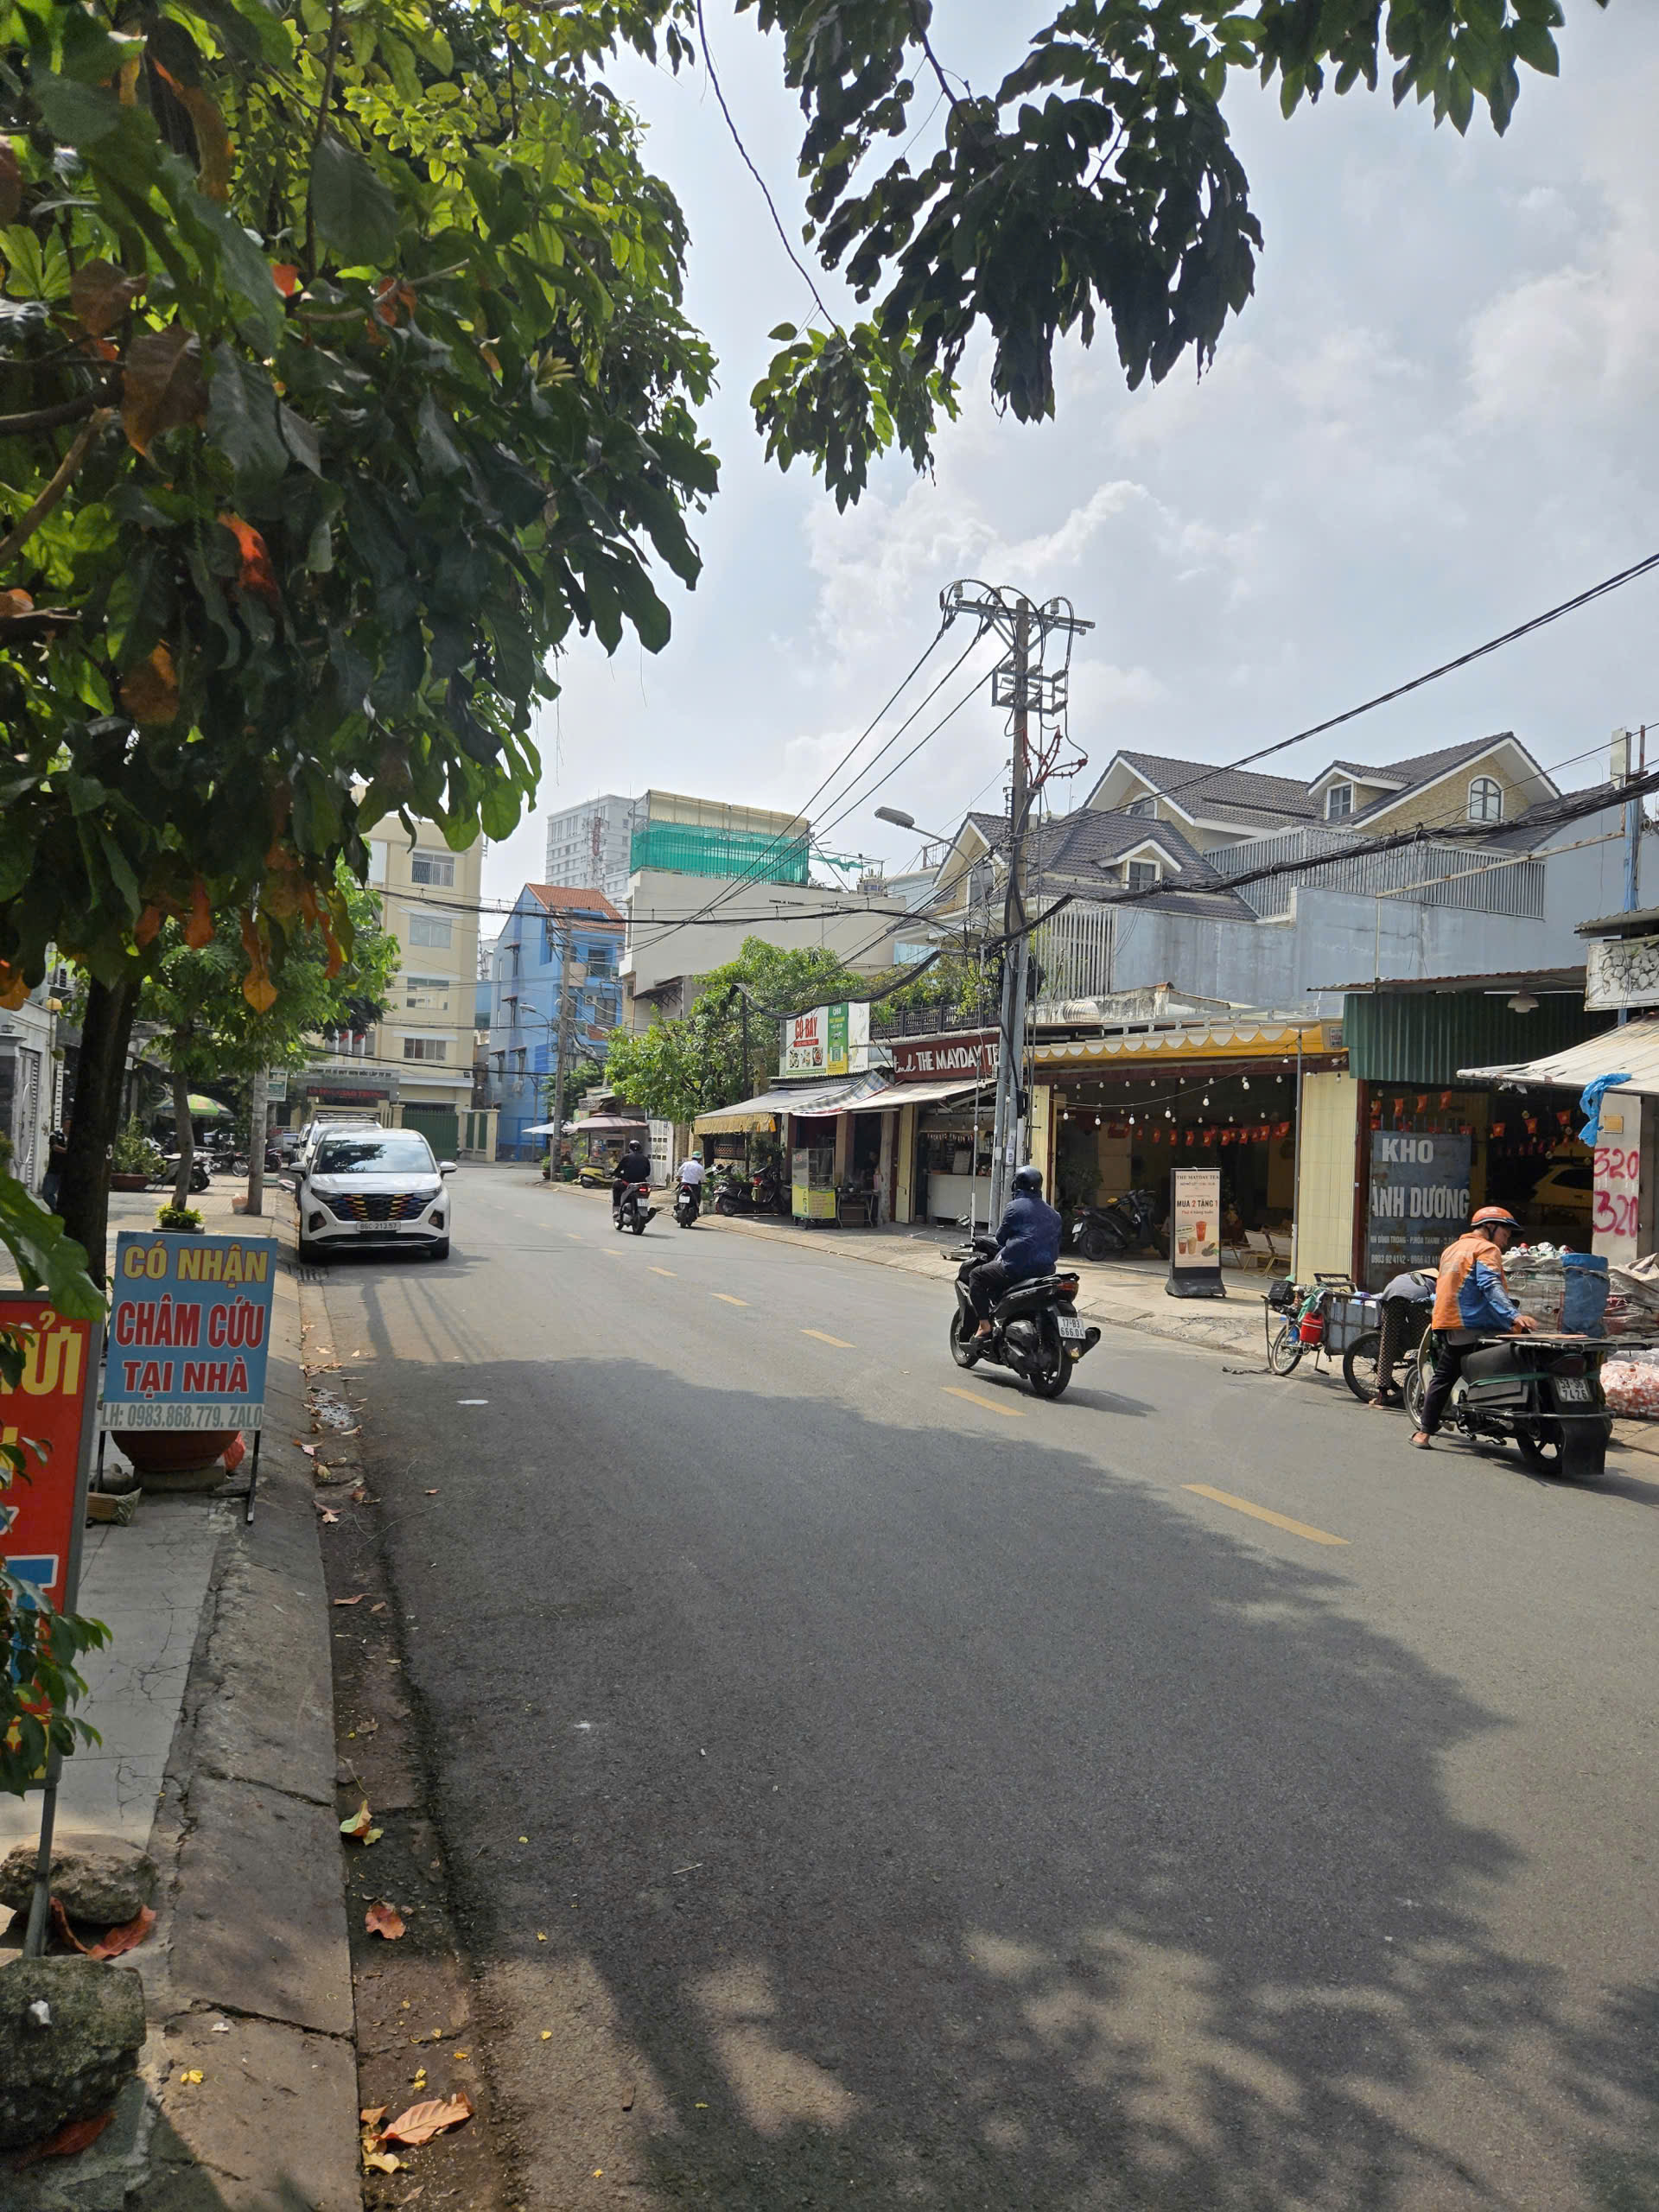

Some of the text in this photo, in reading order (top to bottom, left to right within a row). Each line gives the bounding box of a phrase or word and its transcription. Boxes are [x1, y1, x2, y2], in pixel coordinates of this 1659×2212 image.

[916, 1051, 935, 1071] THE
[936, 1045, 982, 1071] MAYDAY
[1382, 1138, 1434, 1163] KHO
[1594, 1147, 1639, 1179] 320
[1192, 1199, 1197, 1208] 2
[1409, 1185, 1470, 1219] DƯƠNG
[1593, 1191, 1639, 1237] 320
[124, 1240, 269, 1289] CÓ NHẬN
[116, 1293, 266, 1349] CHÂM CỨU
[123, 1354, 250, 1399] TẠI NHÀ
[1562, 1389, 1587, 1401] 7426
[102, 1403, 124, 1427] LH:
[229, 1405, 263, 1427] ZALO
